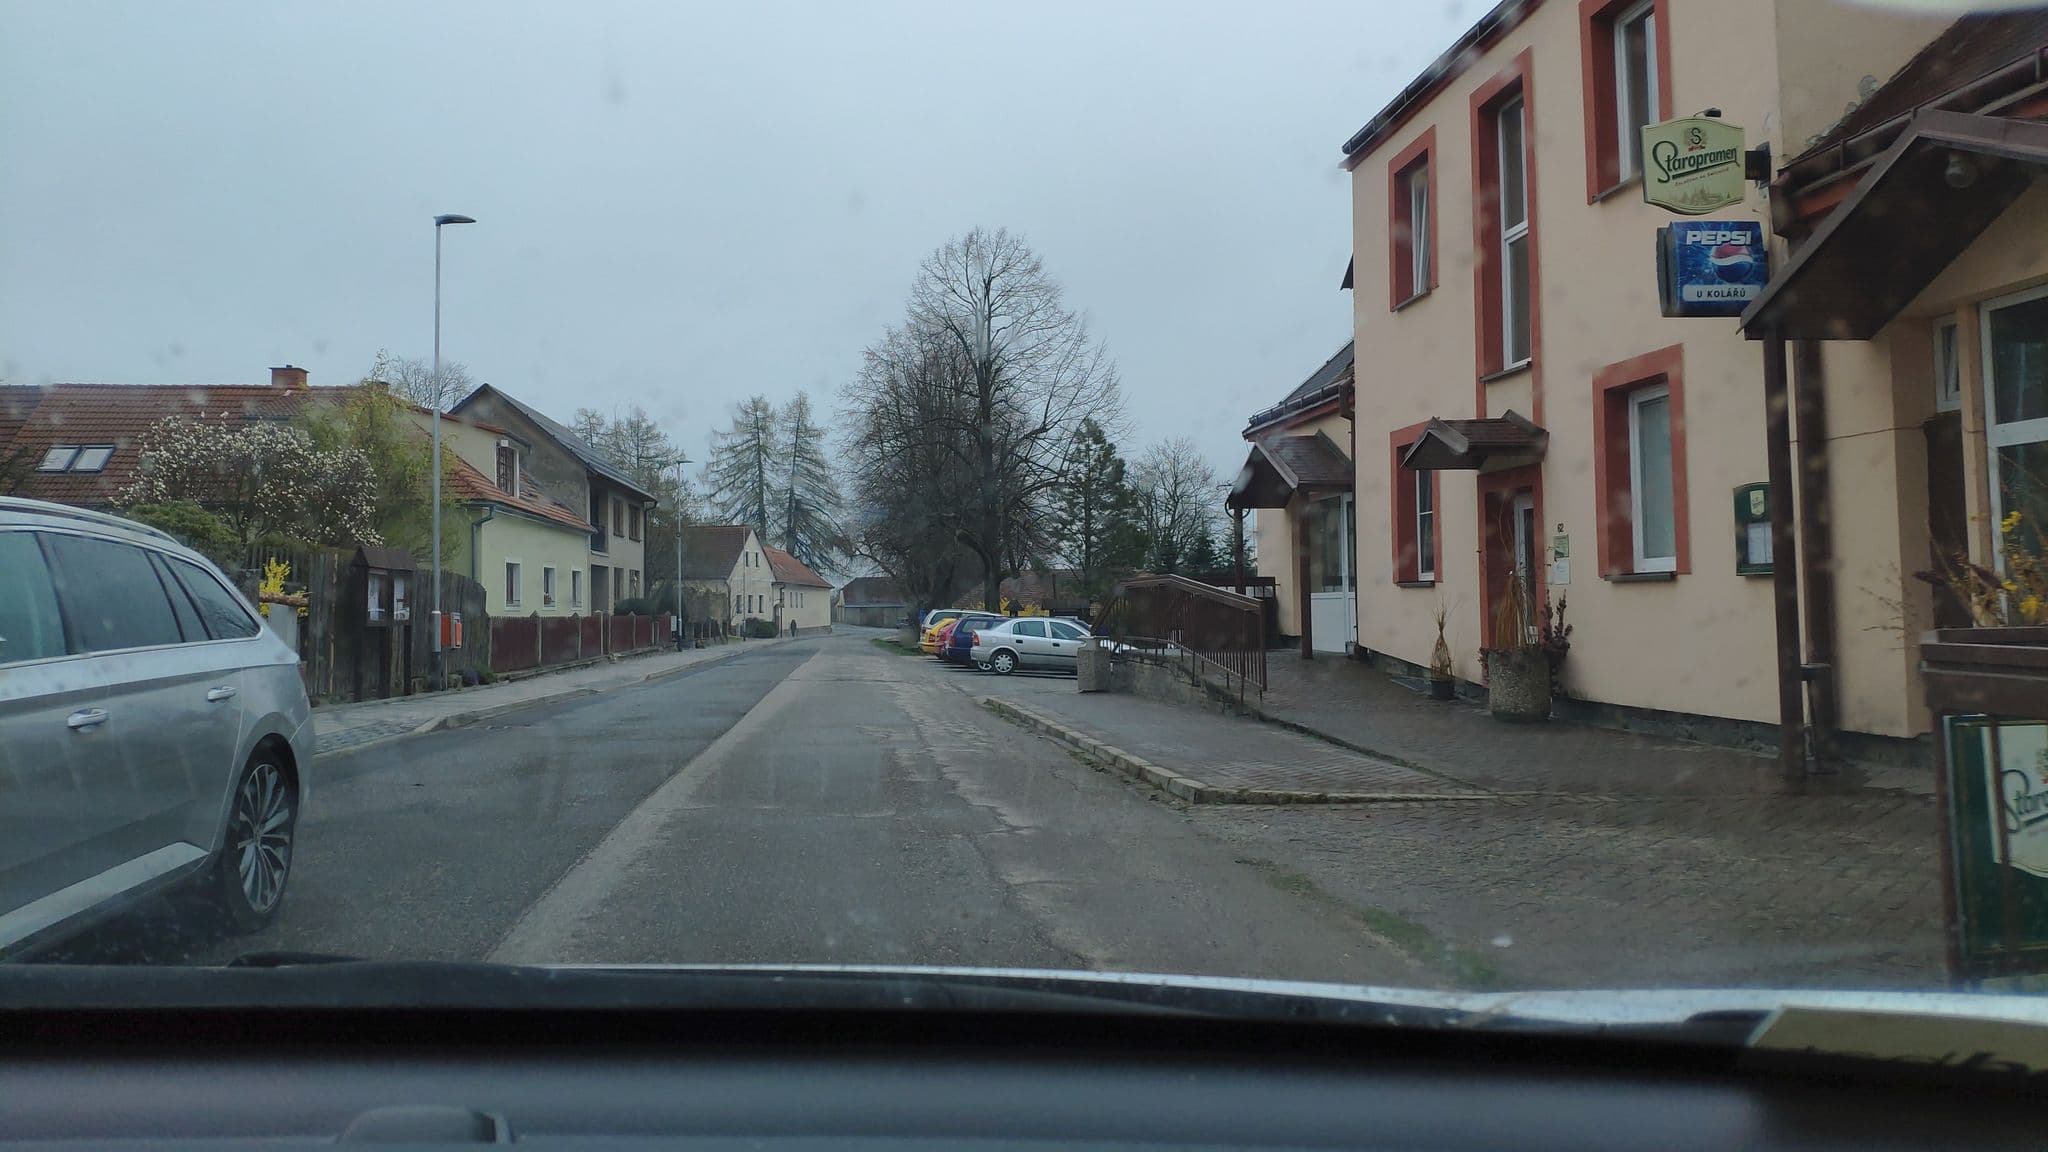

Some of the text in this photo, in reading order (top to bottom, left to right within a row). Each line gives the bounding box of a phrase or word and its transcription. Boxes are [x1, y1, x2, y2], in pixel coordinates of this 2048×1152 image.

[1652, 141, 1738, 183] Staropramen
[1686, 230, 1752, 245] PEPSI
[1696, 290, 1703, 298] U
